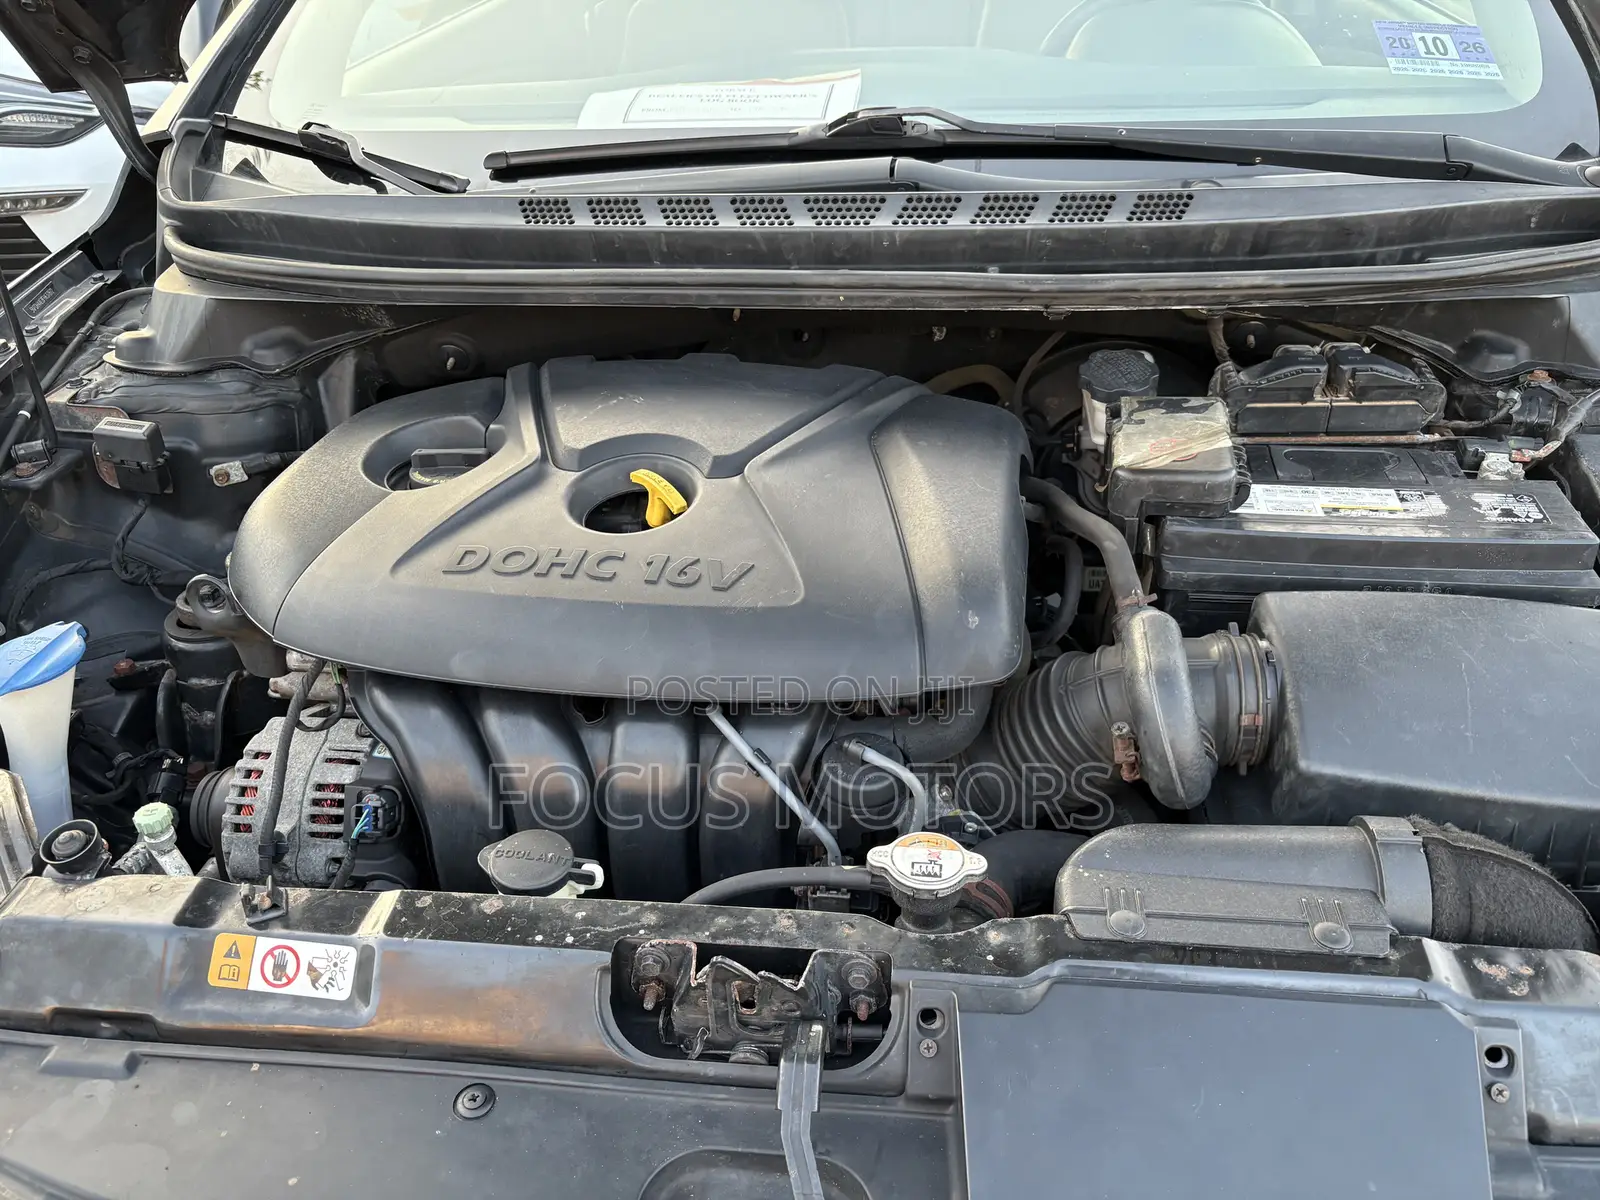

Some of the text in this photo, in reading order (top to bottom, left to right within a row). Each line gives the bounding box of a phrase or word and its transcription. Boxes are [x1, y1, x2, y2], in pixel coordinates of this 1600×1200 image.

[1418, 36, 1448, 56] 10
[1459, 41, 1486, 54] 26
[442, 544, 755, 592] DOHC 16V
[494, 848, 569, 867] COOLANT
